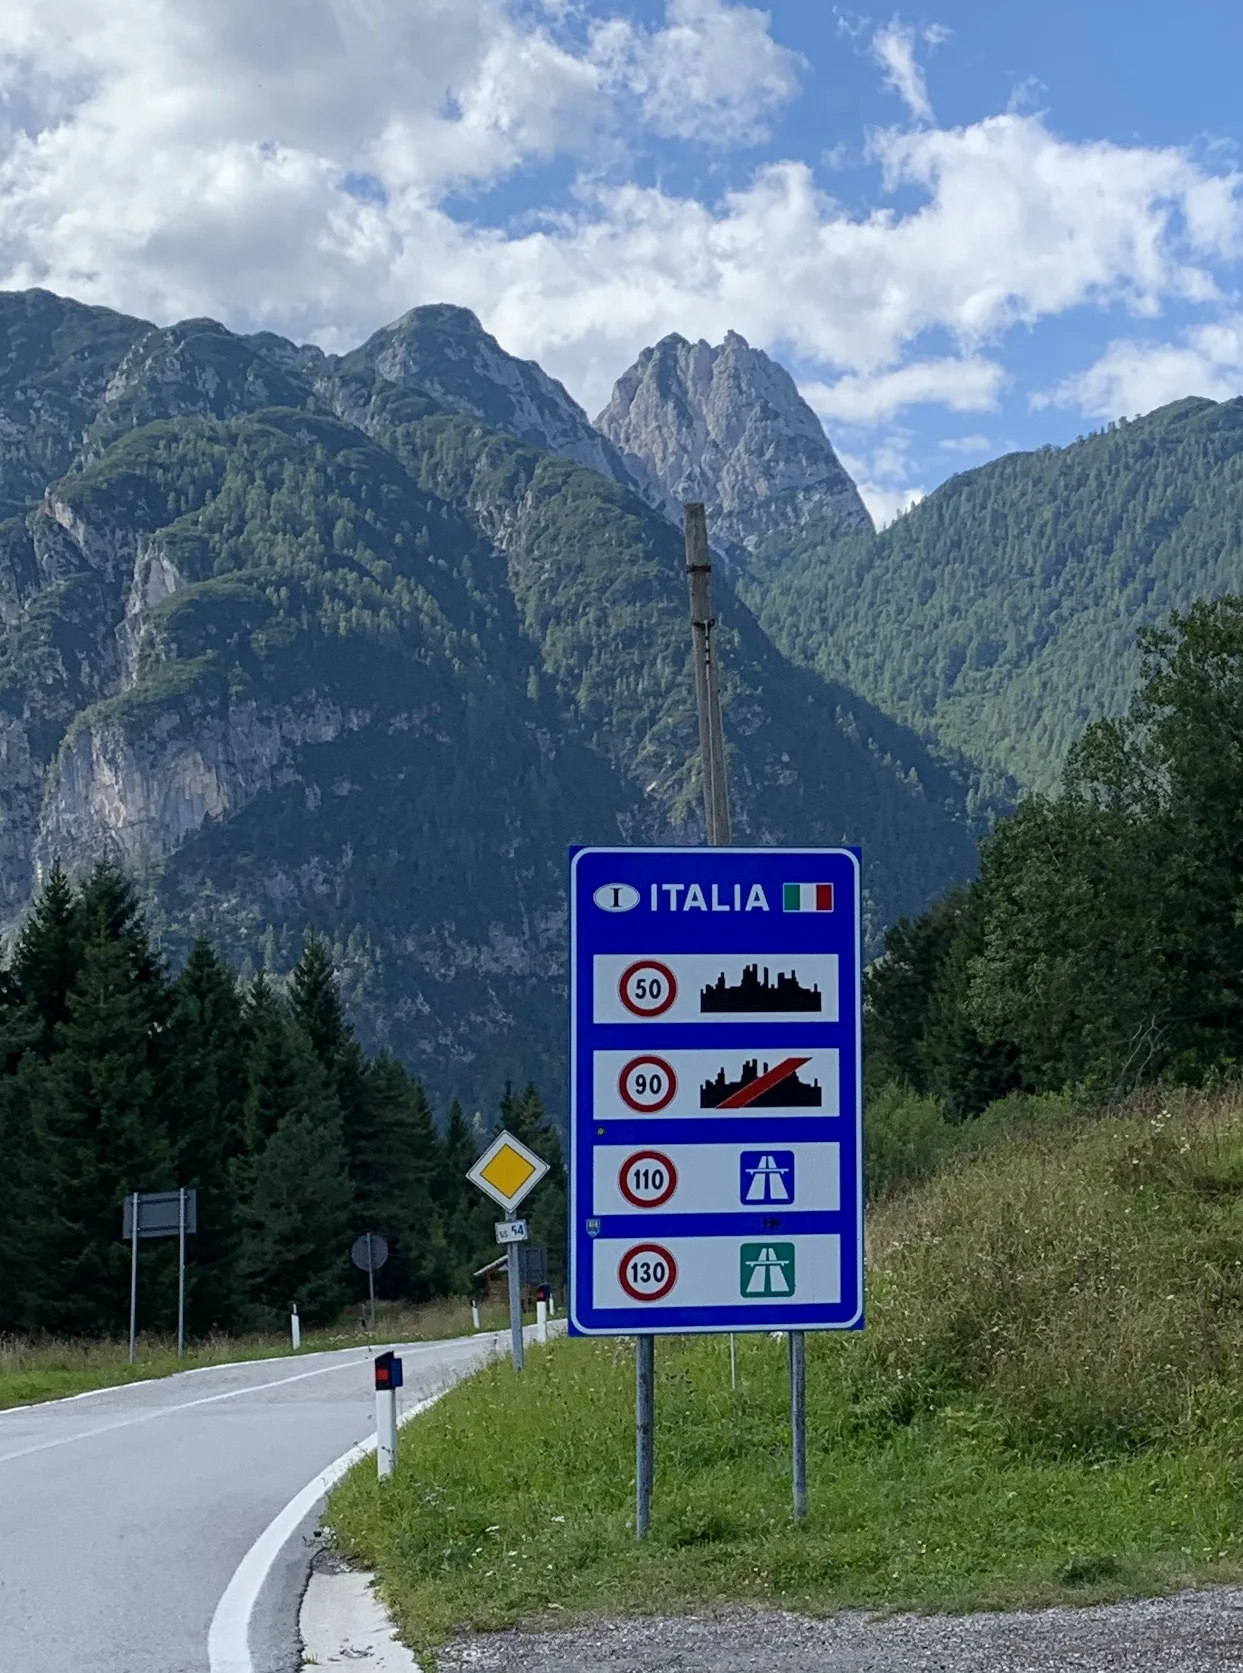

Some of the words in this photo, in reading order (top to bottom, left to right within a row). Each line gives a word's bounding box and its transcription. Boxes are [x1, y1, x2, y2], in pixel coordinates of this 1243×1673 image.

[611, 887, 624, 908] I
[650, 883, 770, 912] ITALIA
[634, 978, 661, 999] 50
[635, 1074, 662, 1095] 90
[633, 1169, 664, 1190] 110
[511, 1225, 524, 1236] 54
[631, 1262, 665, 1283] 130
